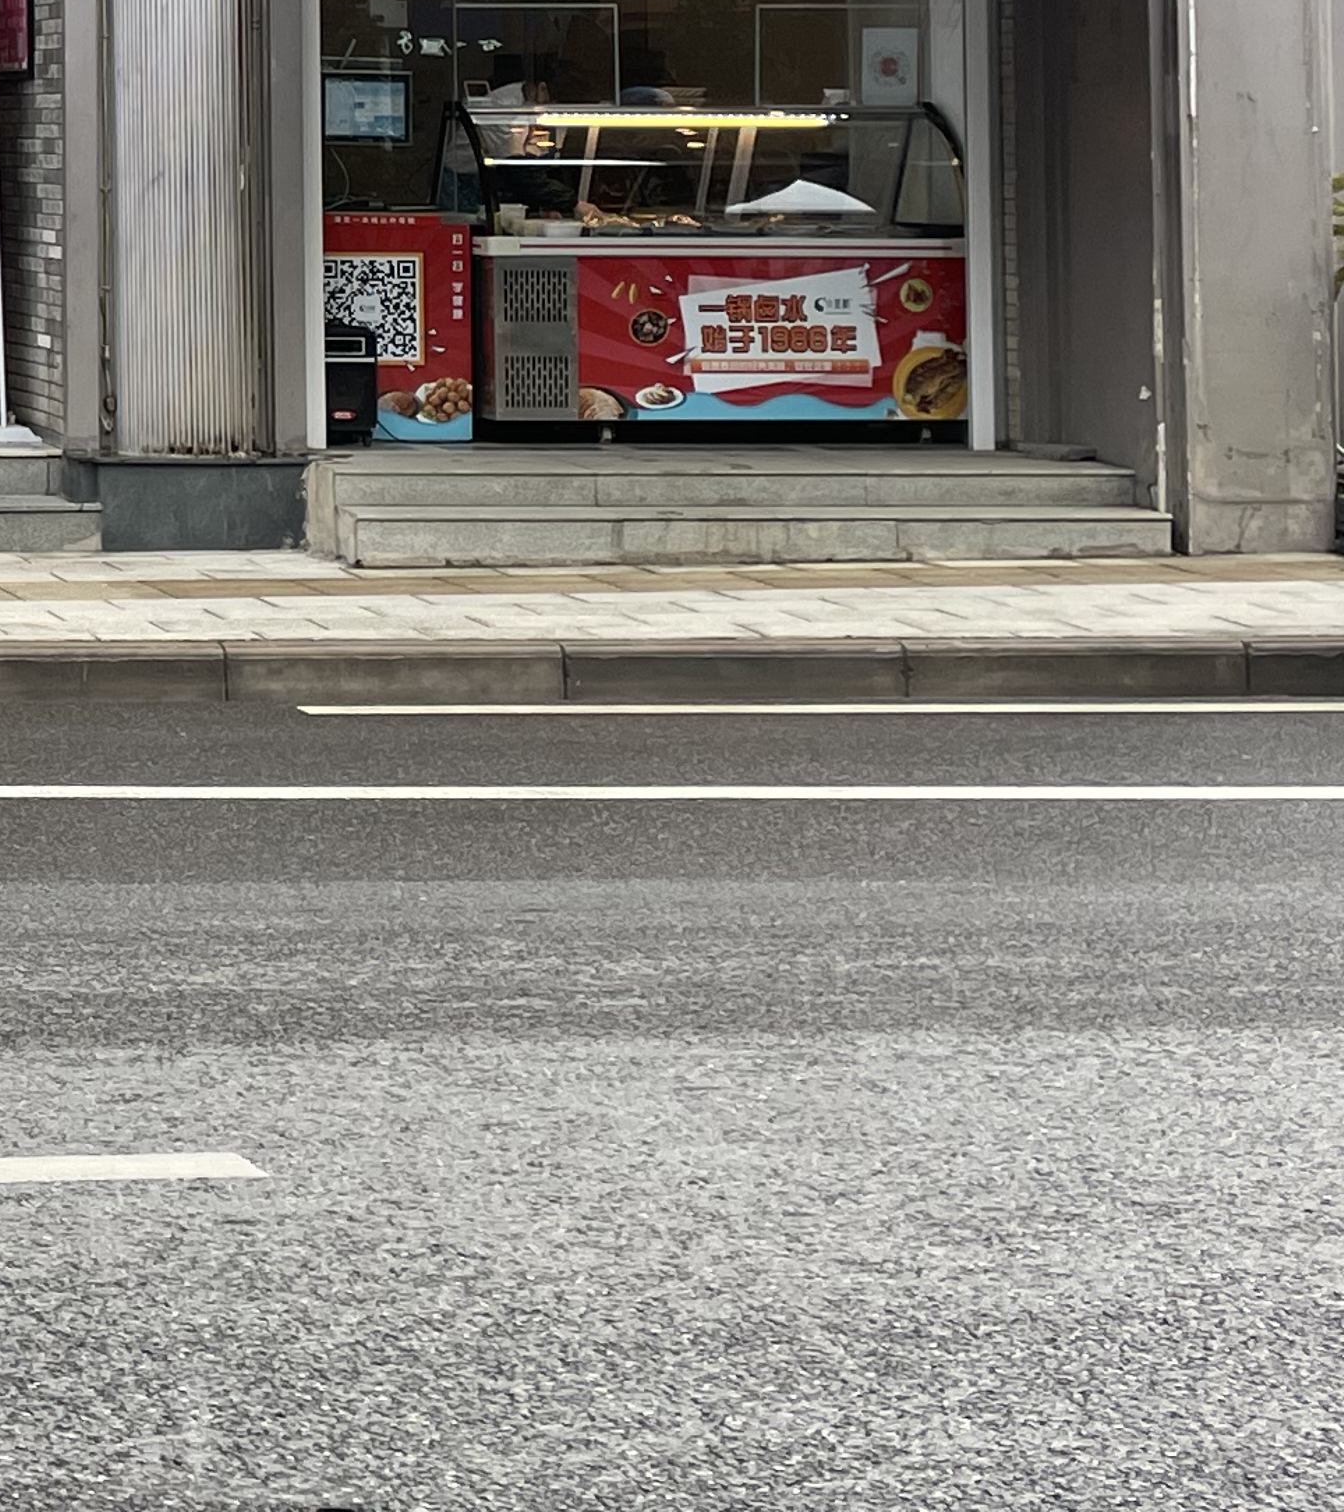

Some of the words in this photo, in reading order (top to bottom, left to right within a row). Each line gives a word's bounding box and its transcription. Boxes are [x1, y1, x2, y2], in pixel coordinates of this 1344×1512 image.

[698, 294, 808, 323] 一锅卤水
[701, 324, 857, 354] 始于1986年
